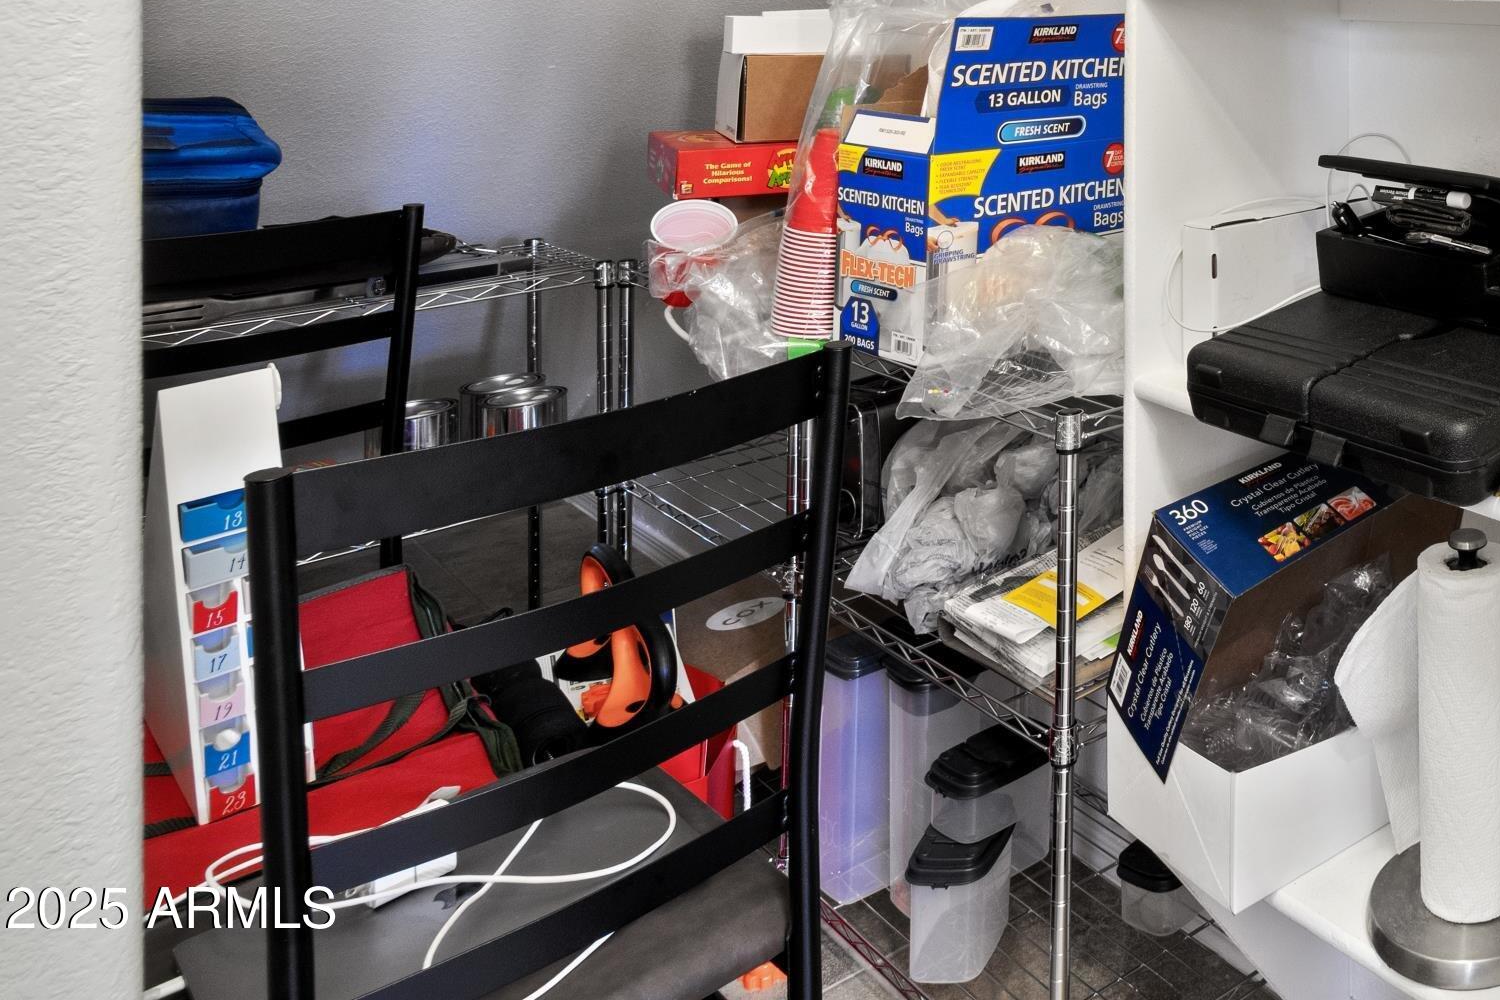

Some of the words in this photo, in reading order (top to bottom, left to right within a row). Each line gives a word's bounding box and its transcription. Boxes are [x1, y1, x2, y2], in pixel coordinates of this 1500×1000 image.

[1033, 26, 1078, 37] KIRKLAND
[1075, 82, 1108, 90] DRAWSTRING
[988, 93, 1004, 108] 13
[1007, 89, 1061, 106] GALLON
[1074, 90, 1108, 109] Bags
[1014, 125, 1043, 137] FRESH
[1043, 122, 1071, 135] SCENT
[704, 162, 719, 170] The
[864, 156, 903, 172] KIRKLAND
[1019, 153, 1065, 167] KIRKLAND
[1104, 150, 1113, 168] 7
[703, 175, 753, 185] Comparisons!
[711, 169, 745, 177] Hilarious
[838, 187, 880, 208] SCENTED
[881, 195, 925, 216] KITCHEN
[974, 187, 1055, 219] SCENTED
[1059, 179, 1125, 206] KITCHEN
[904, 222, 924, 236] Bags
[1093, 210, 1124, 228] Bags
[841, 249, 917, 289] FLEX-TECH
[858, 283, 873, 293] FRESH
[873, 286, 890, 298] SCENT
[850, 300, 870, 324] 13
[850, 321, 868, 331] GALLON
[1238, 461, 1283, 485] KIRKLAND
[1230, 486, 1264, 508] Crystal
[1263, 477, 1288, 492] Clear
[1287, 462, 1320, 480] Cutlery
[1254, 490, 1299, 518] Transparente
[1299, 478, 1328, 495] Acabado
[1278, 501, 1296, 514] Tipo
[1295, 491, 1317, 506] Cristal
[223, 510, 243, 532] 13
[1168, 499, 1209, 526] 360
[229, 555, 246, 573] 14
[206, 608, 225, 628] 15
[1127, 609, 1144, 657] KIRKLAND
[210, 653, 227, 673] 17
[1127, 683, 1142, 718] Crystal
[1137, 658, 1150, 684] Clear
[1145, 621, 1162, 660] Cutlery
[213, 701, 233, 721] 19
[218, 751, 238, 772] 21
[223, 790, 247, 811] 23
